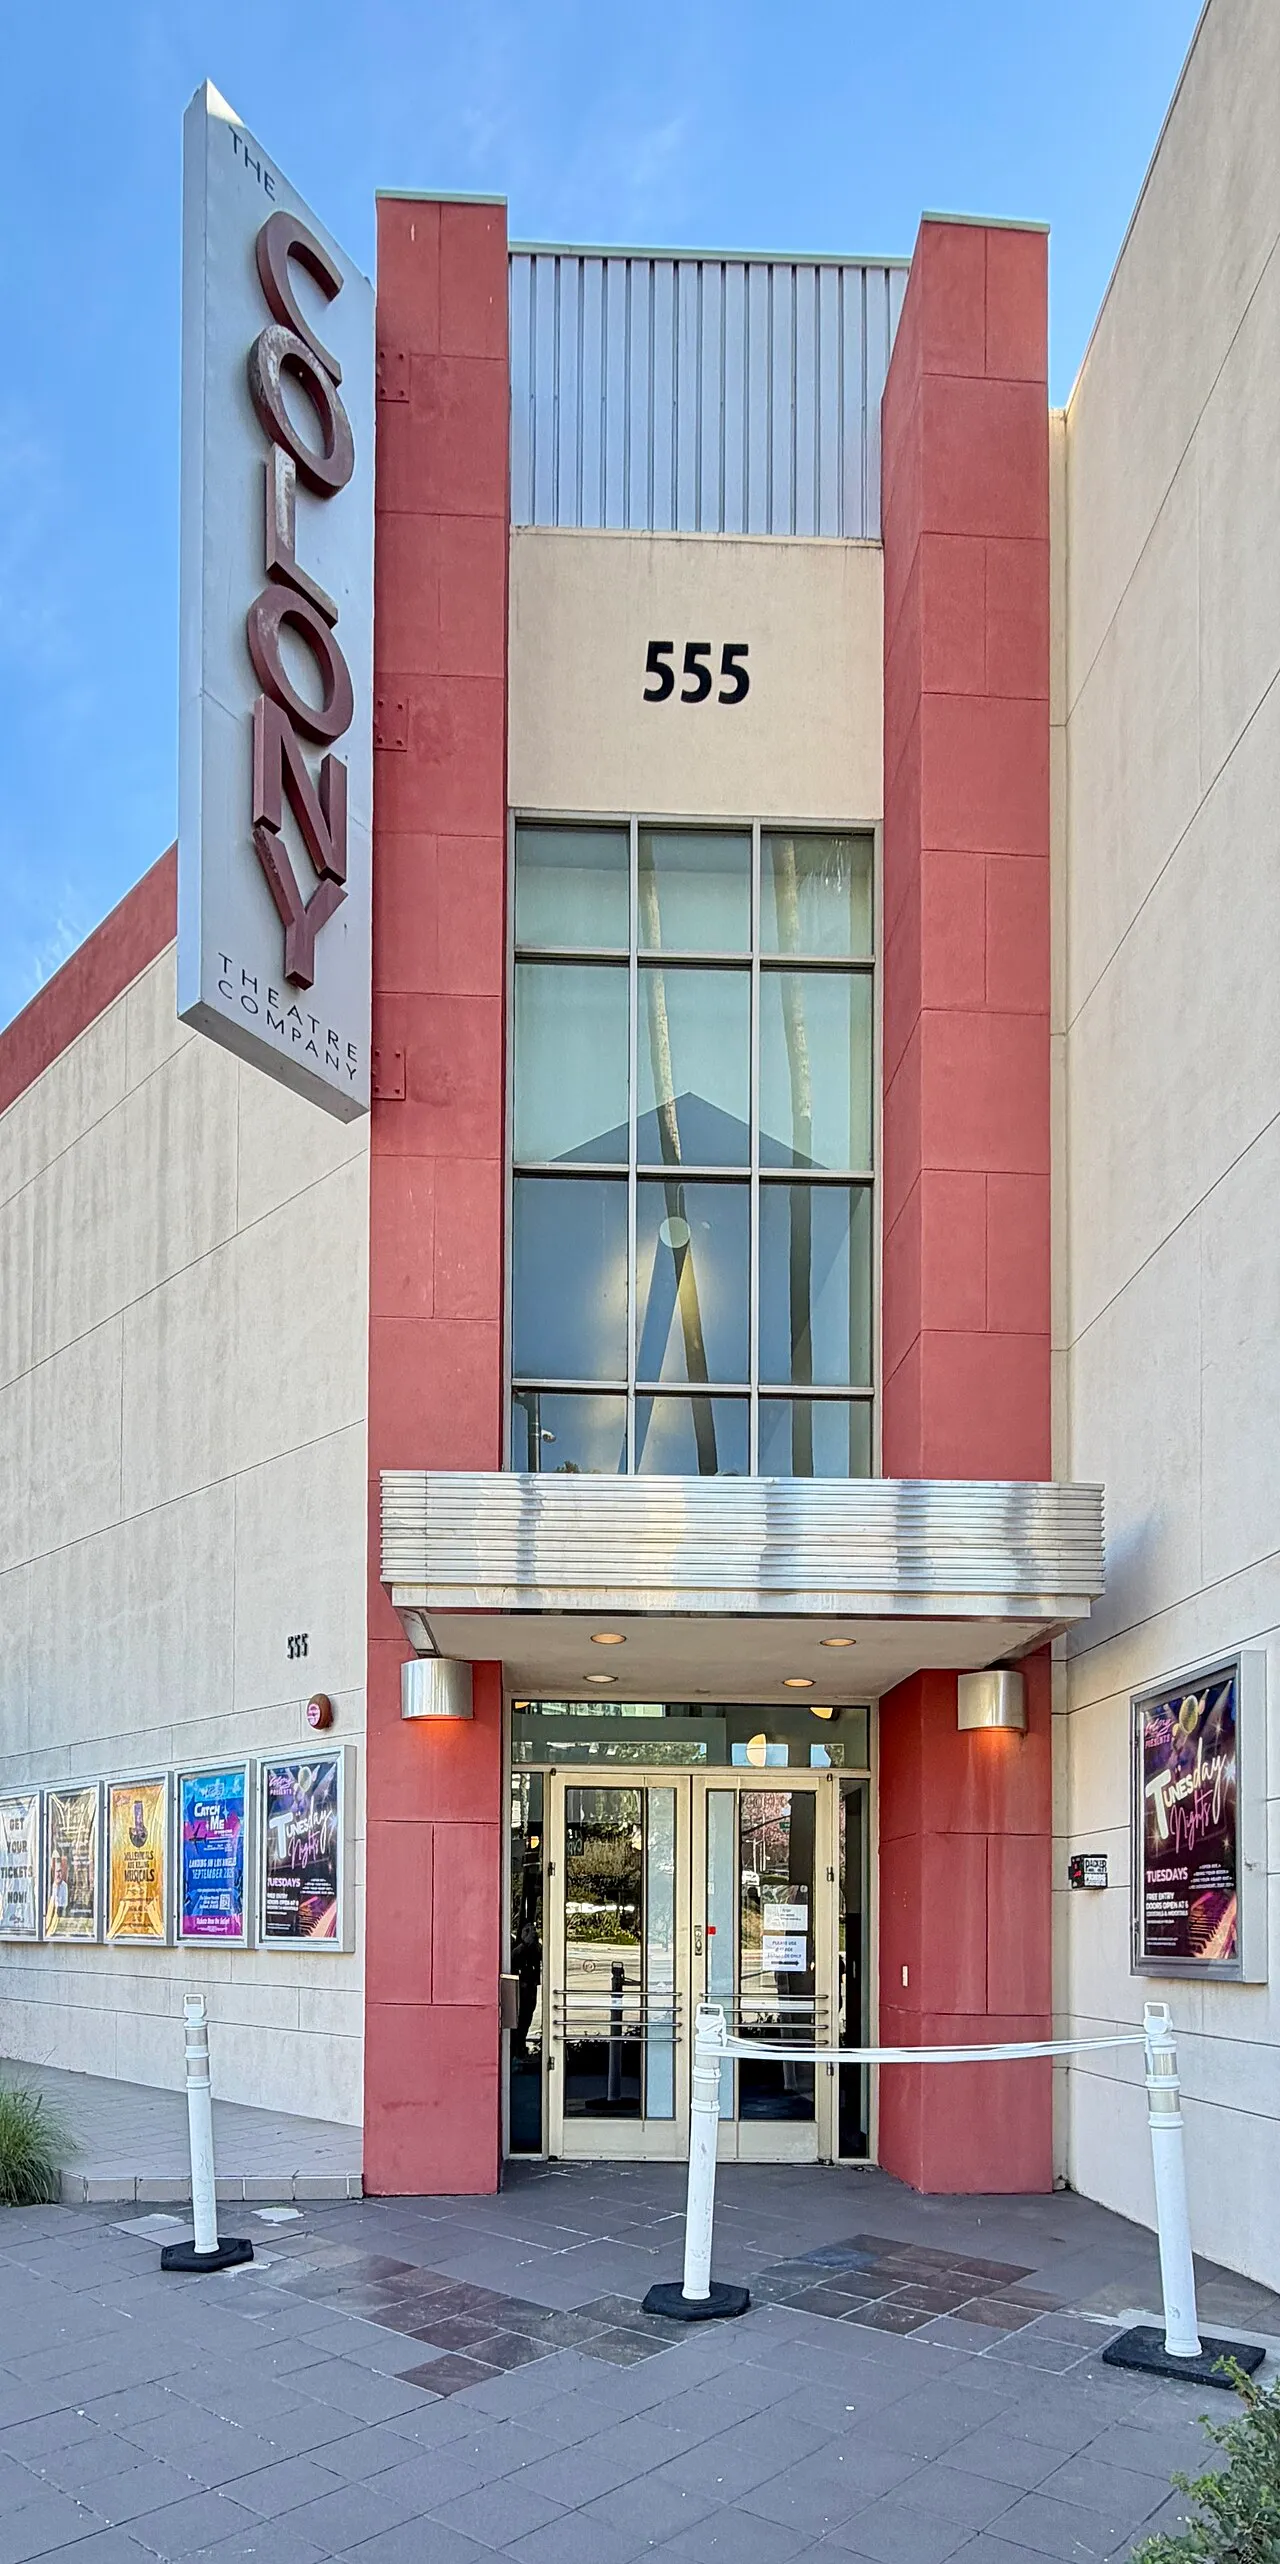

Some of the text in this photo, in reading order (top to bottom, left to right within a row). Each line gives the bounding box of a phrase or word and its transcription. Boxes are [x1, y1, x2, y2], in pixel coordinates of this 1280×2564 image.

[226, 125, 277, 203] THE
[247, 209, 355, 992] COLONY
[643, 640, 750, 705] 555
[218, 952, 358, 1064] THEATRE
[218, 978, 358, 1082] COMPANY
[287, 1633, 309, 1660] 555
[9, 1818, 25, 1831] GET
[1170, 1789, 1213, 1854] Nights
[6, 1840, 28, 1853] YOUR
[1, 1866, 33, 1879] TICKETS
[267, 1877, 301, 1888] TUESDAYS
[1146, 1866, 1188, 1883] TUESDAYS
[7, 1891, 27, 1904] NOW!
